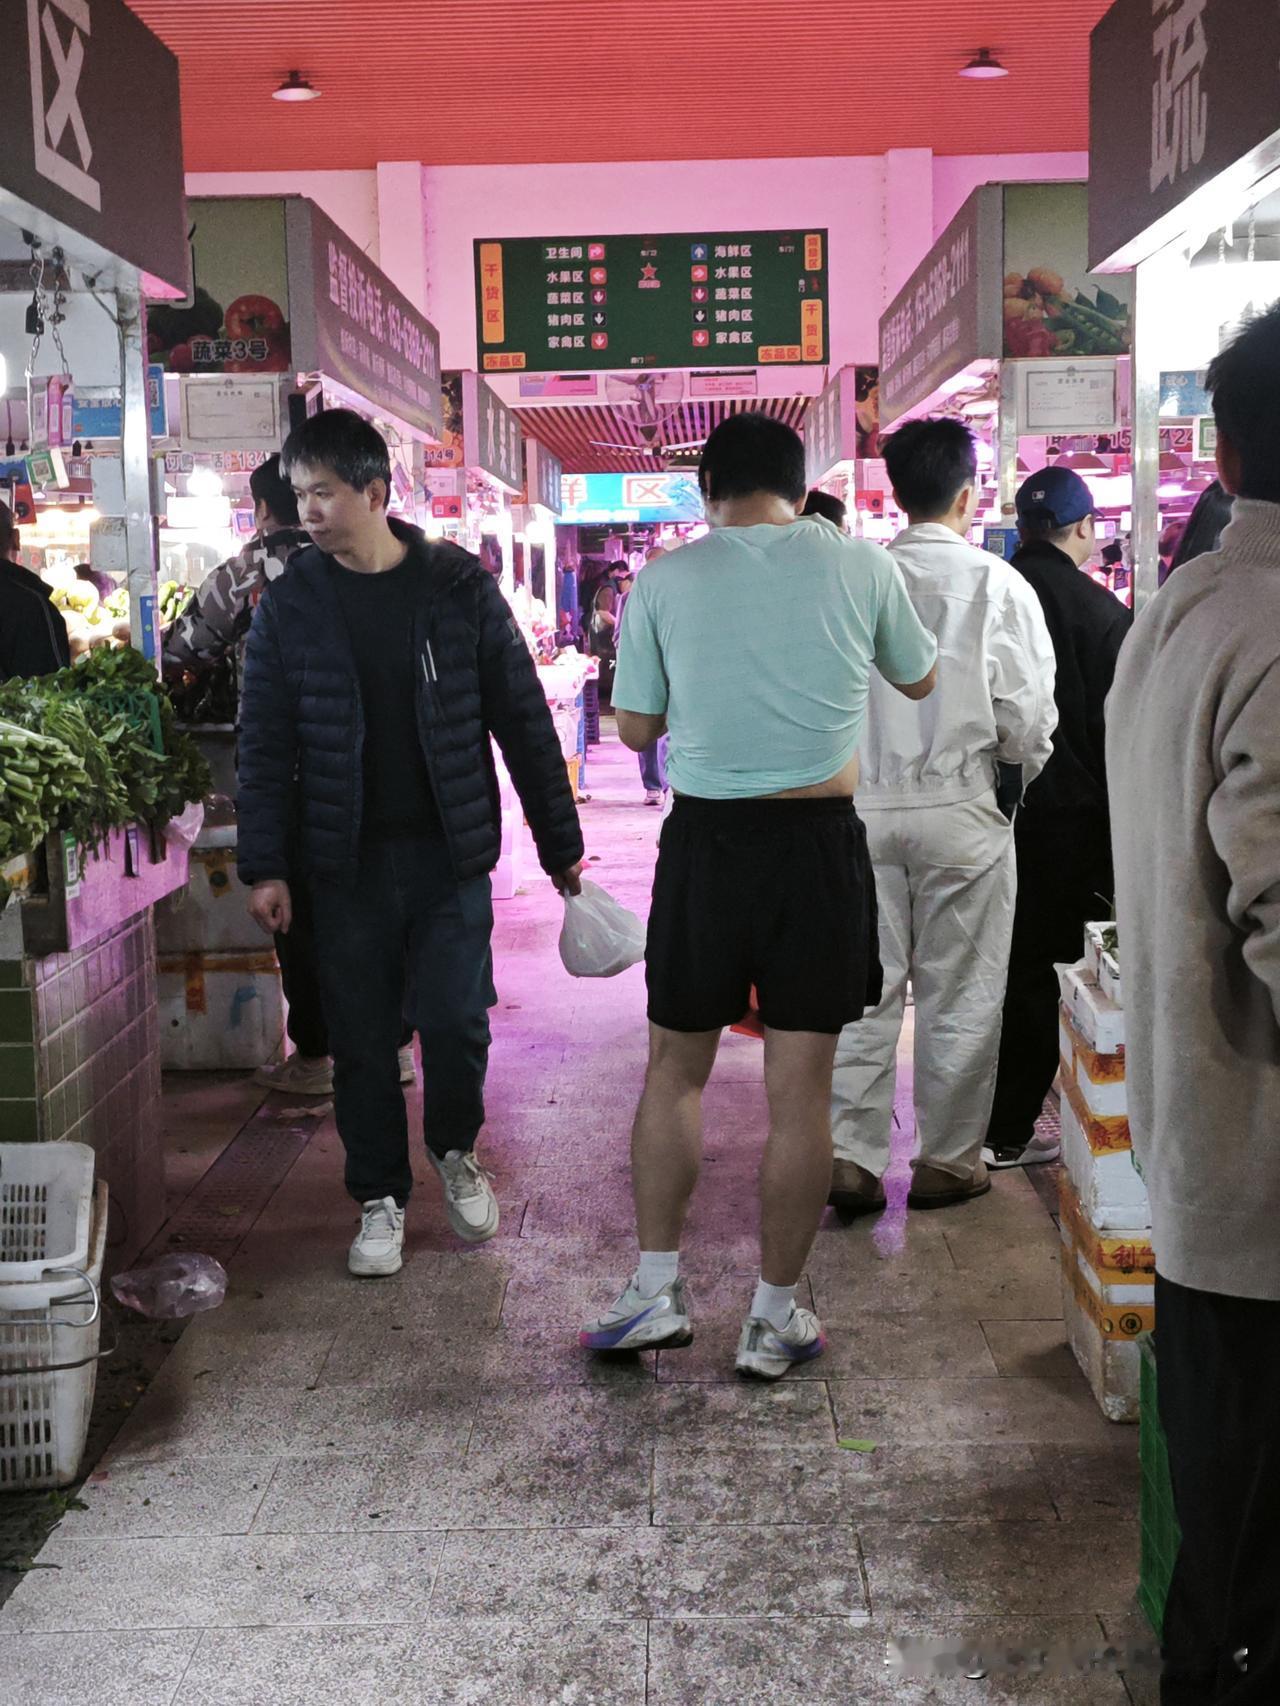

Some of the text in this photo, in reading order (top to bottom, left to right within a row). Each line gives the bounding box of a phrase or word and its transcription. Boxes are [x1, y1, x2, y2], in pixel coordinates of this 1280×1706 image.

[27, 0, 101, 213] 区
[545, 246, 583, 259] 卫生间
[714, 244, 753, 258] 海鲜区
[546, 270, 585, 284] 水果区
[714, 266, 753, 279] 水果区
[546, 291, 585, 305] 蔬菜区
[714, 287, 753, 300] 蔬菜区
[547, 313, 586, 327] 猪肉区
[714, 309, 754, 322] 猪肉区
[547, 335, 586, 349] 家禽区
[715, 331, 754, 344] 家禽区
[192, 338, 269, 362] 蔬菜3号
